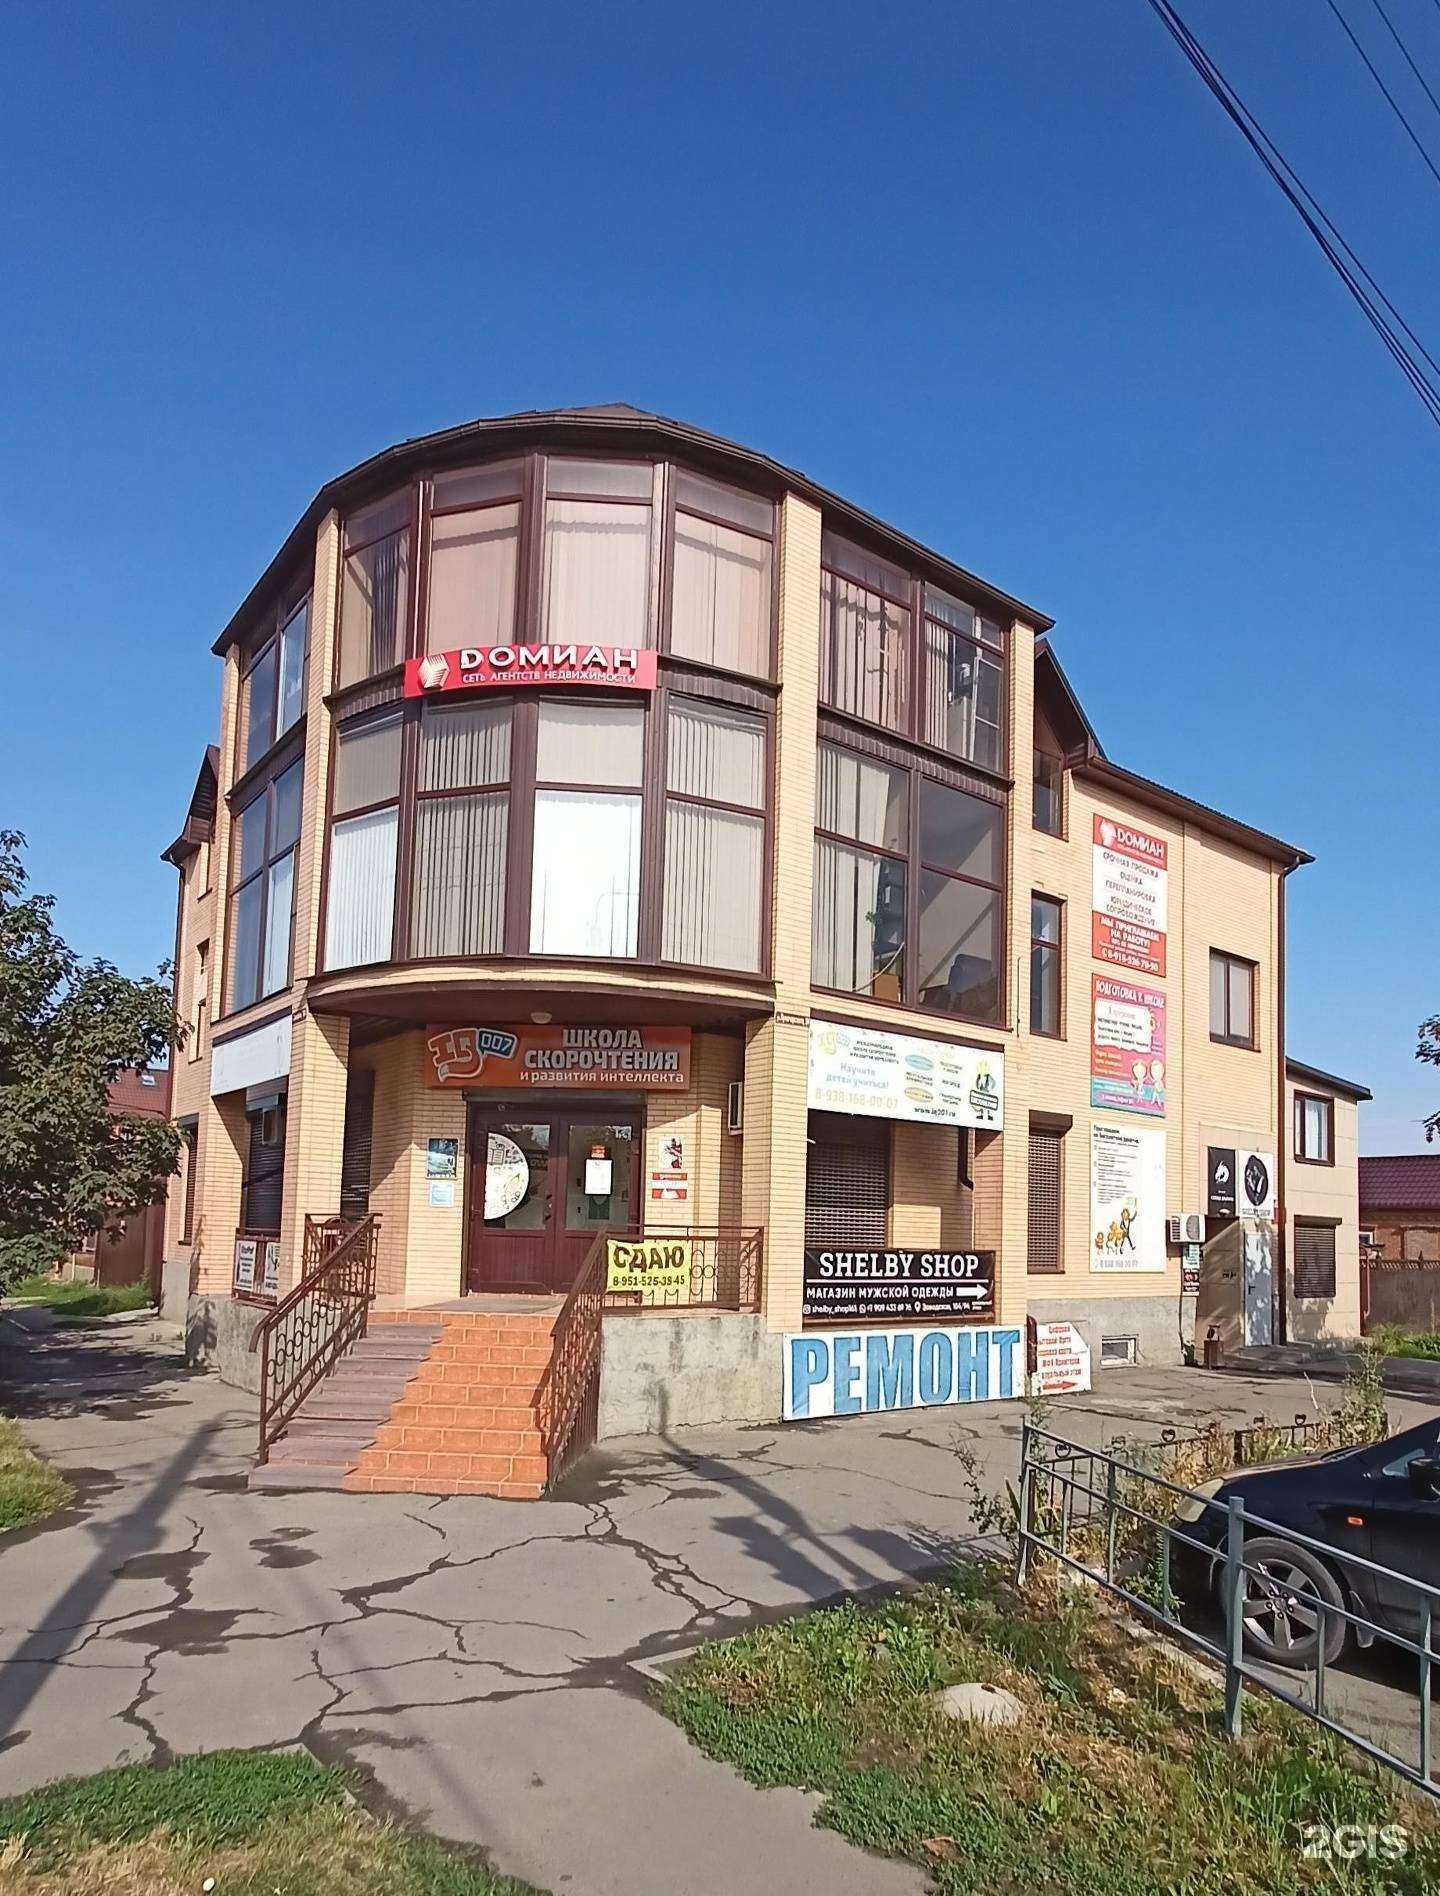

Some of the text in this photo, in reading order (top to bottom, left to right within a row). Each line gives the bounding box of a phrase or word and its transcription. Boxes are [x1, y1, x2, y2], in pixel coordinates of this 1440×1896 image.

[462, 669, 636, 684] СЕТЬ АГЕНТСТВ НЕДВИЖИМОСТИ
[481, 1033, 512, 1051] 007
[562, 1029, 643, 1048] ШКОЛА
[524, 1050, 679, 1070] СКОРОЧТЕНИЯ
[520, 1071, 684, 1084] и развития интеллекта
[613, 1246, 685, 1273] СДАЮ
[819, 1252, 979, 1277] SHELBY SHOP
[806, 1285, 954, 1299] МАГАЗИН МУЖСКОЙ ОДЕЖДЫ
[791, 1329, 1020, 1417] РЕМОНТ
